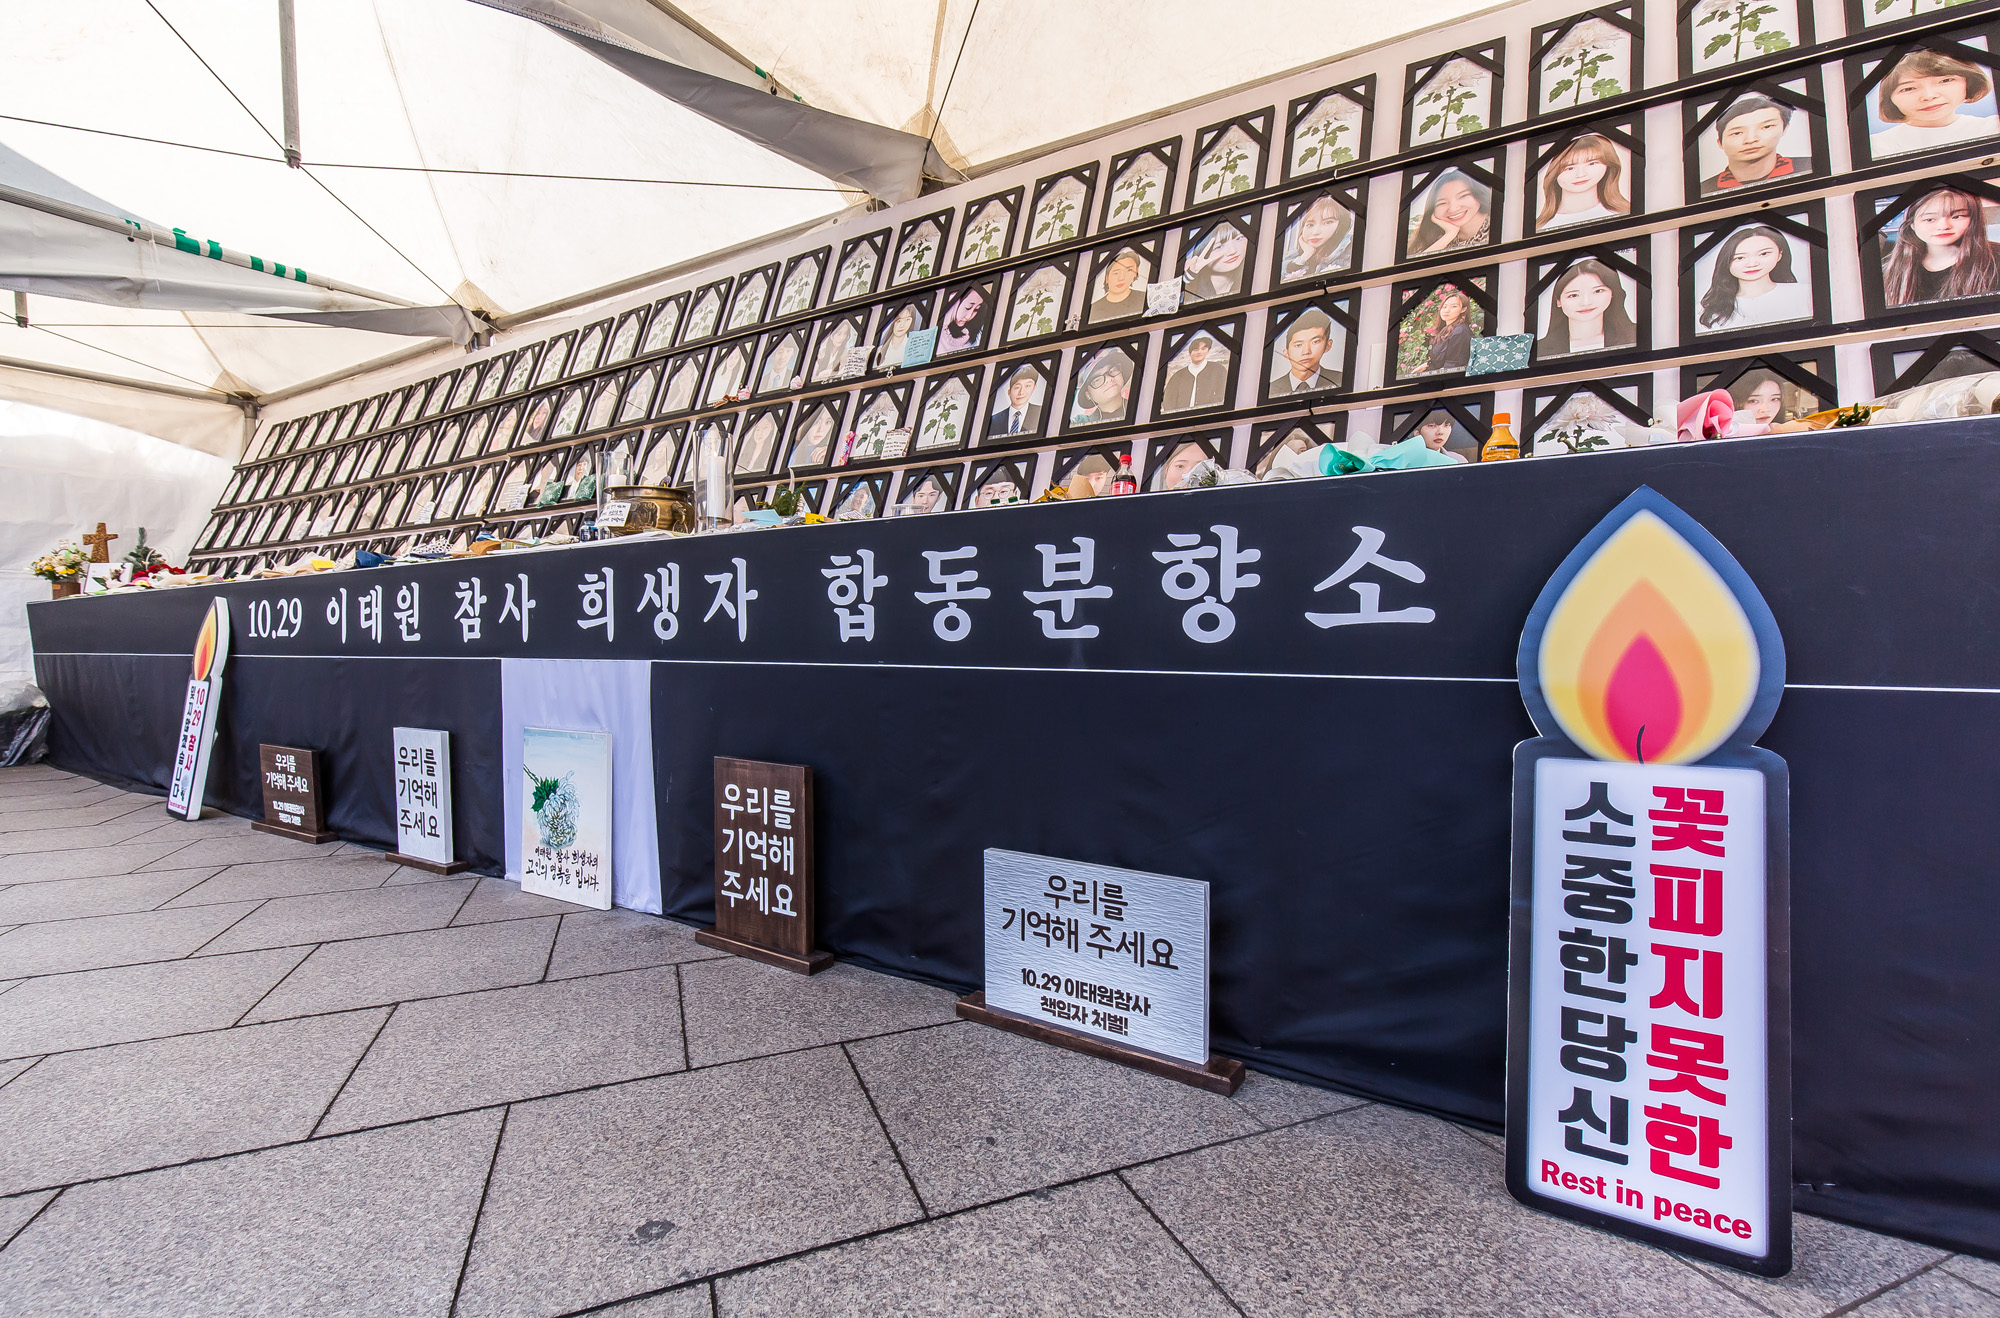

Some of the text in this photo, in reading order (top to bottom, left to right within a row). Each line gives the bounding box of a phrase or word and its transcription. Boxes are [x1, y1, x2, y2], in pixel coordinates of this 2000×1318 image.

[248, 525, 1436, 644] 10.29 이태원 참사 희생자 합동분향소
[266, 772, 310, 793] 기억해 주세요
[275, 753, 297, 773] 우리를
[398, 747, 437, 777] 우리를
[399, 778, 438, 809] 기억해
[721, 784, 796, 829] 우리를
[400, 809, 440, 838] 주세요
[526, 858, 548, 880] 고인의
[535, 846, 552, 860] 이태원
[556, 849, 570, 863] 참사
[722, 828, 795, 875] 기억해
[721, 870, 797, 917] 주세요
[1043, 875, 1129, 921] 우리를
[1002, 907, 1179, 970] 기억해 주세요
[1021, 968, 1151, 1017] 10.29 이태원참사
[1040, 995, 1129, 1037] 책임자 처벌!
[1541, 1159, 1752, 1239] Rest in peace
